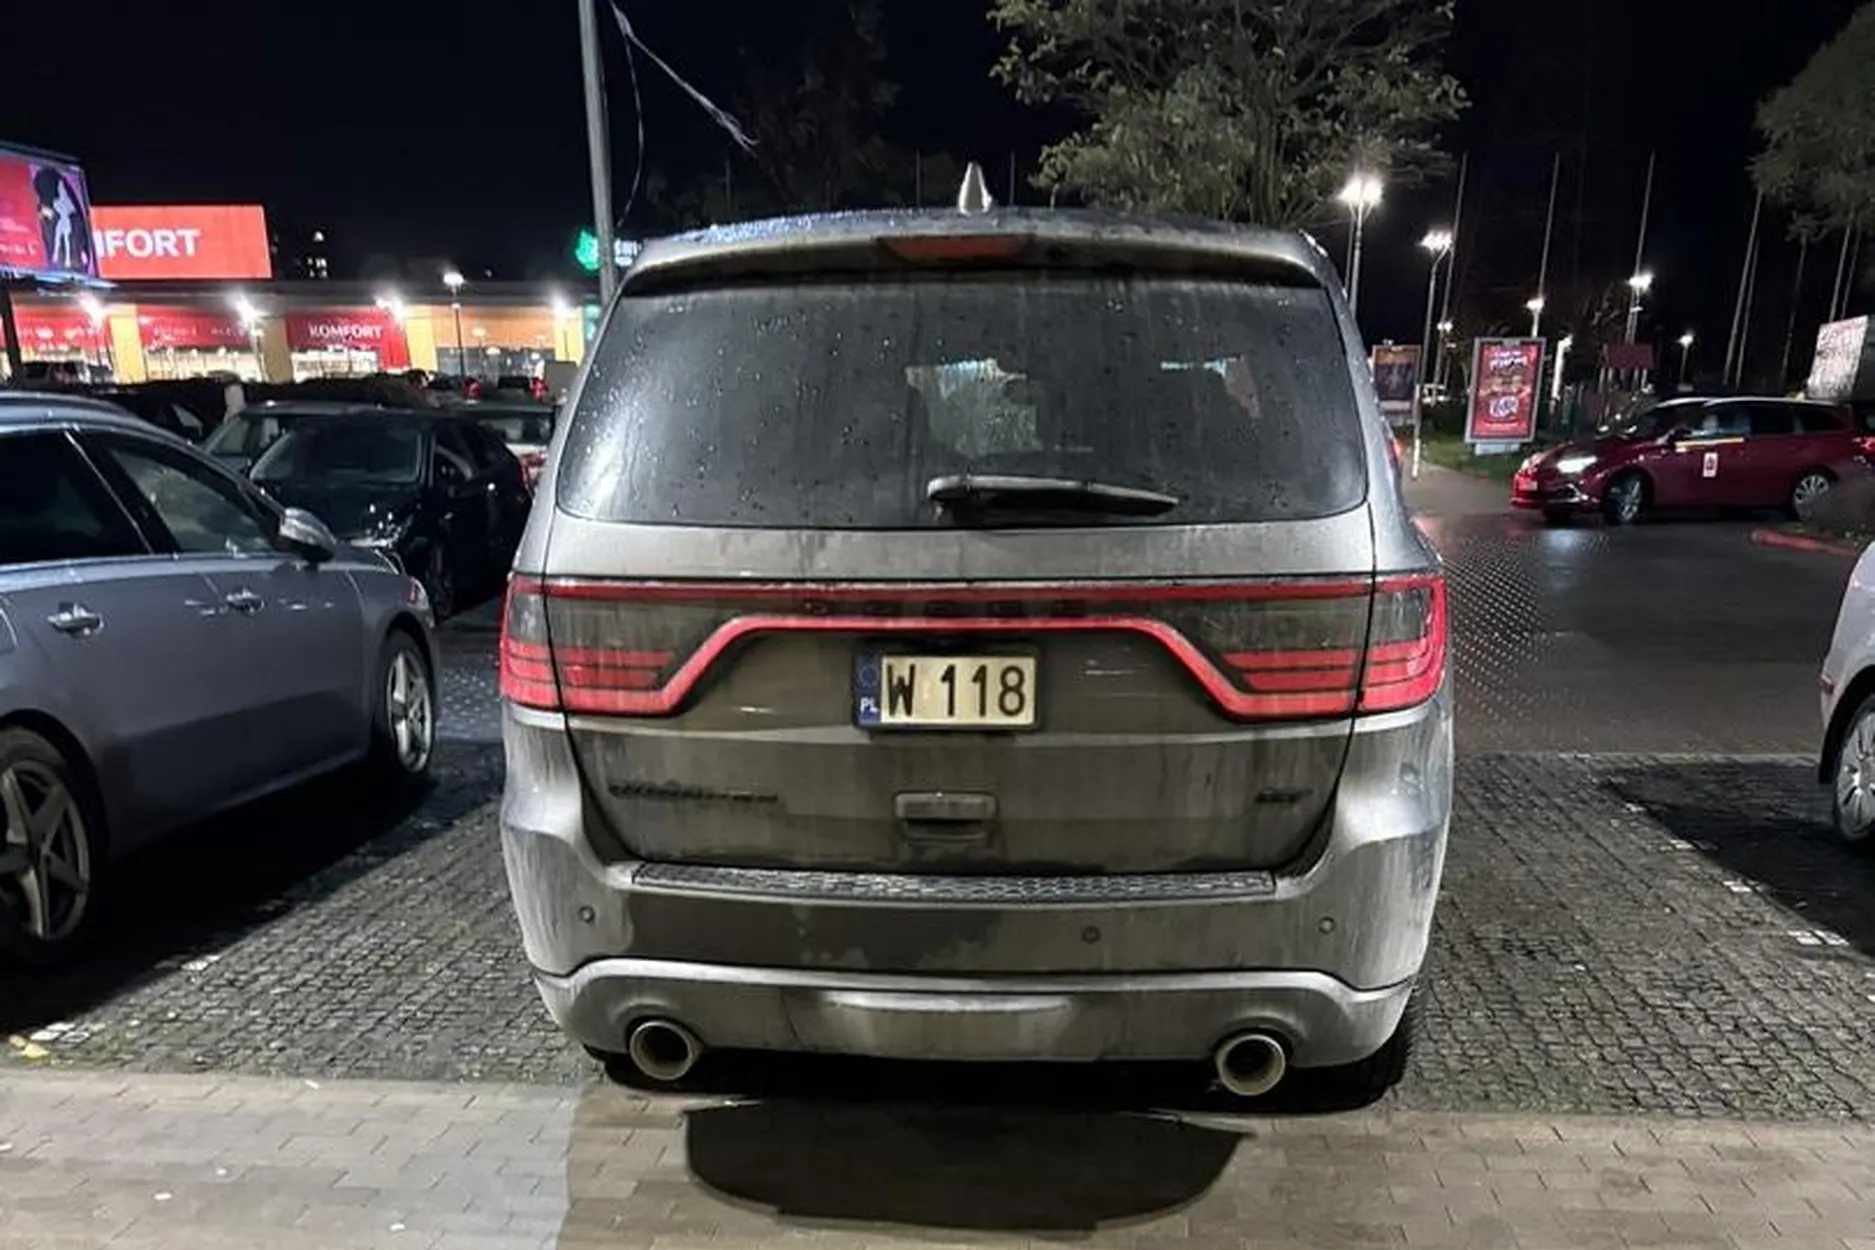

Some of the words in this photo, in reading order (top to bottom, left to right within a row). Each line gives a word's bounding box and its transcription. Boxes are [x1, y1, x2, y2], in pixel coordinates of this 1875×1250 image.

[308, 324, 382, 339] KOMFORT
[886, 663, 916, 717] W
[941, 663, 1025, 718] 118
[860, 697, 879, 714] PL
